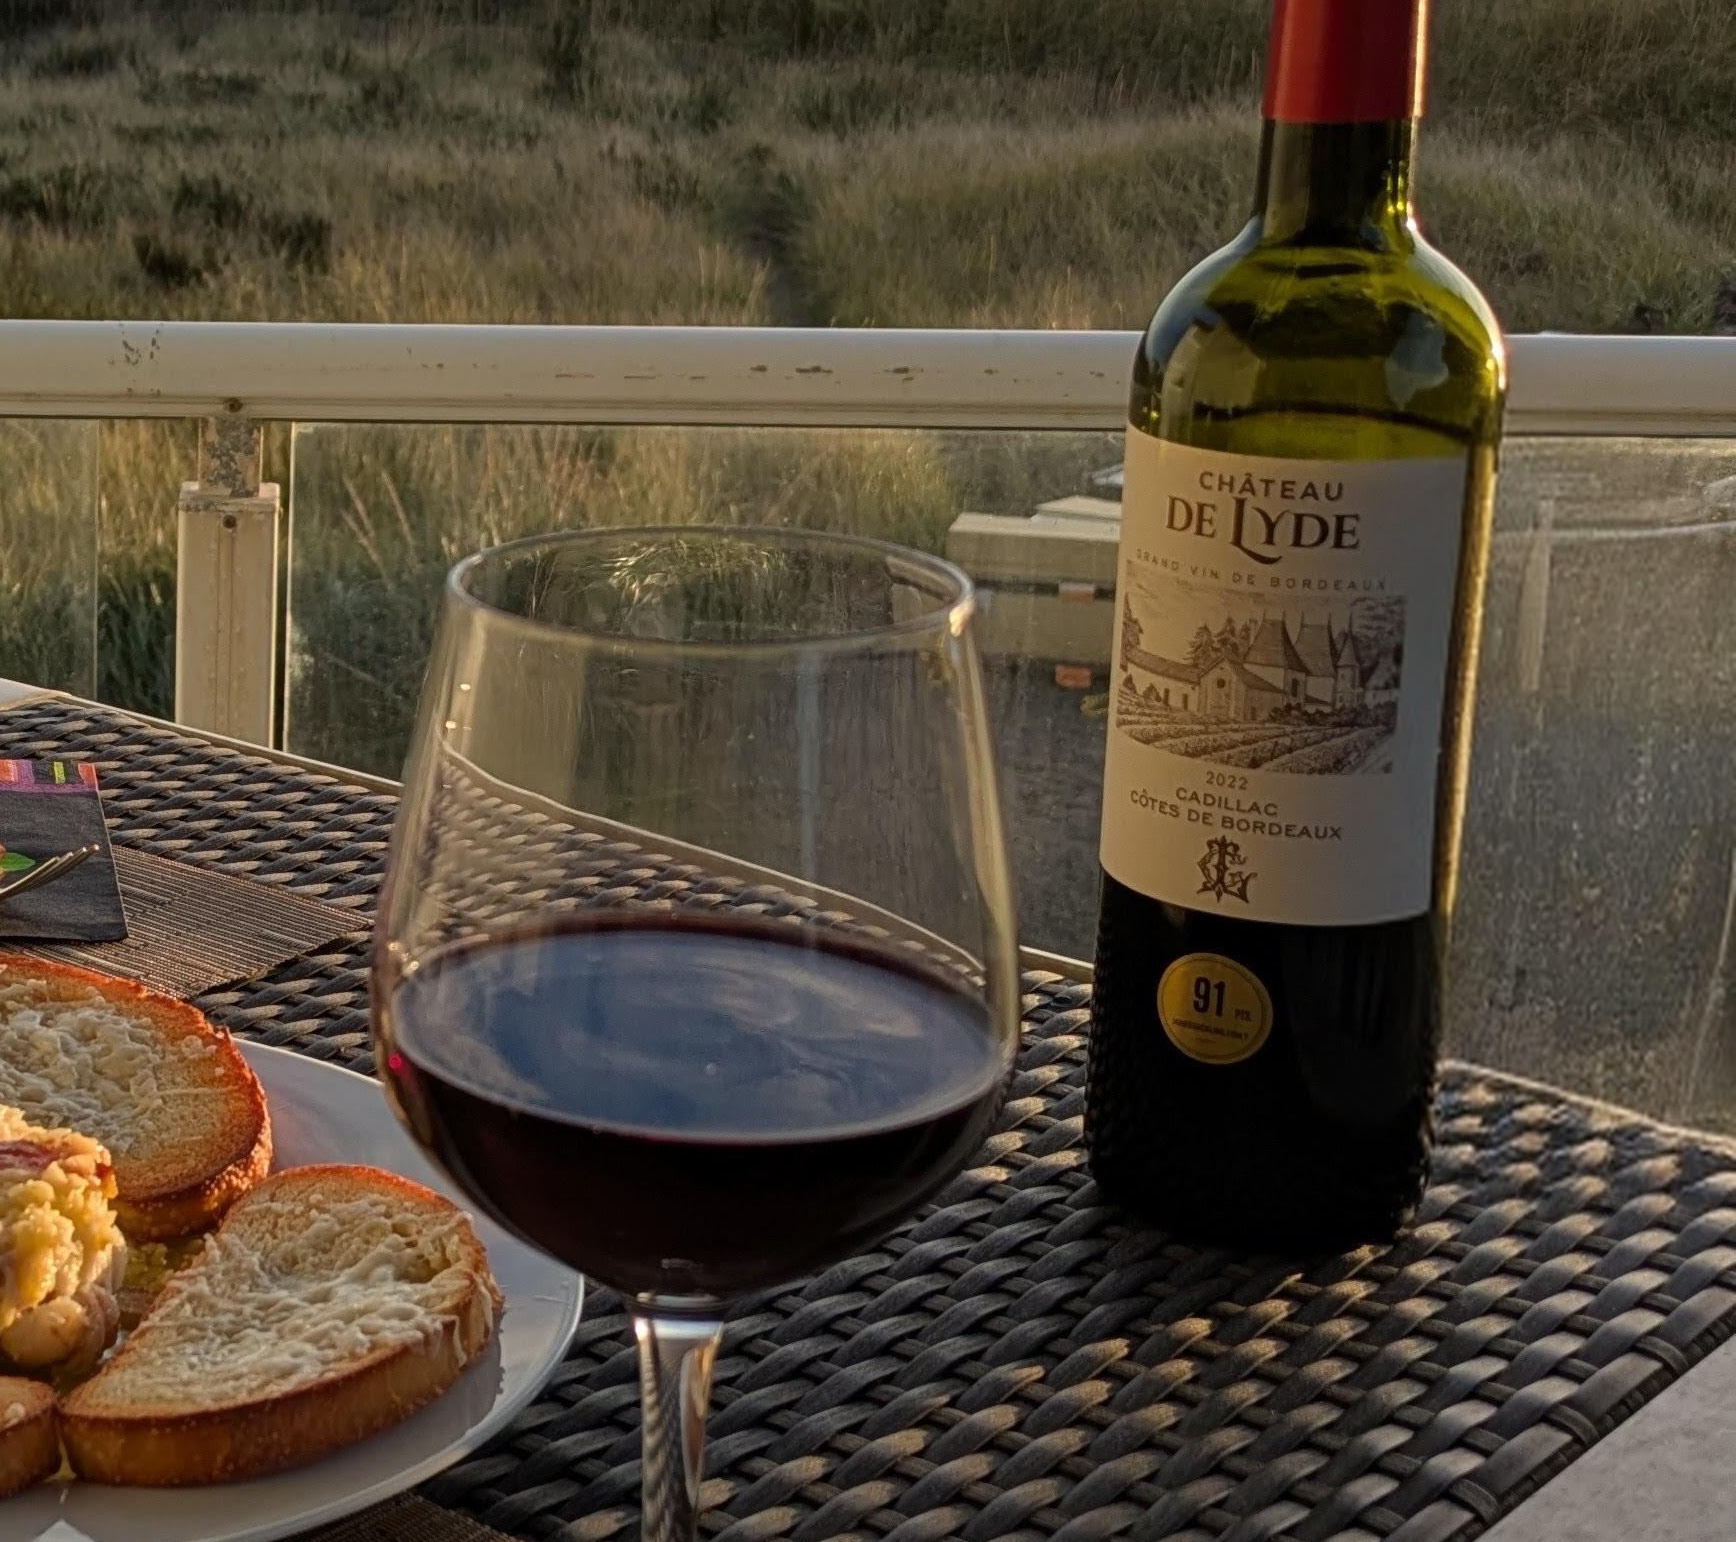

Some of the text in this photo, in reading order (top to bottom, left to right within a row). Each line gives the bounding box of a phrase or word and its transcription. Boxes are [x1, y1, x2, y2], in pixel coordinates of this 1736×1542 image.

[1199, 471, 1343, 501] CHÂTEAU
[1166, 495, 1216, 538] DE
[1136, 548, 1387, 591] GRAND VIN DE BORDEAUX
[1206, 770, 1248, 791] 2022
[1130, 788, 1342, 840] CÔTES DE BORDEAUX
[1175, 787, 1278, 817] CADILLAC
[1193, 976, 1226, 1017] 91
